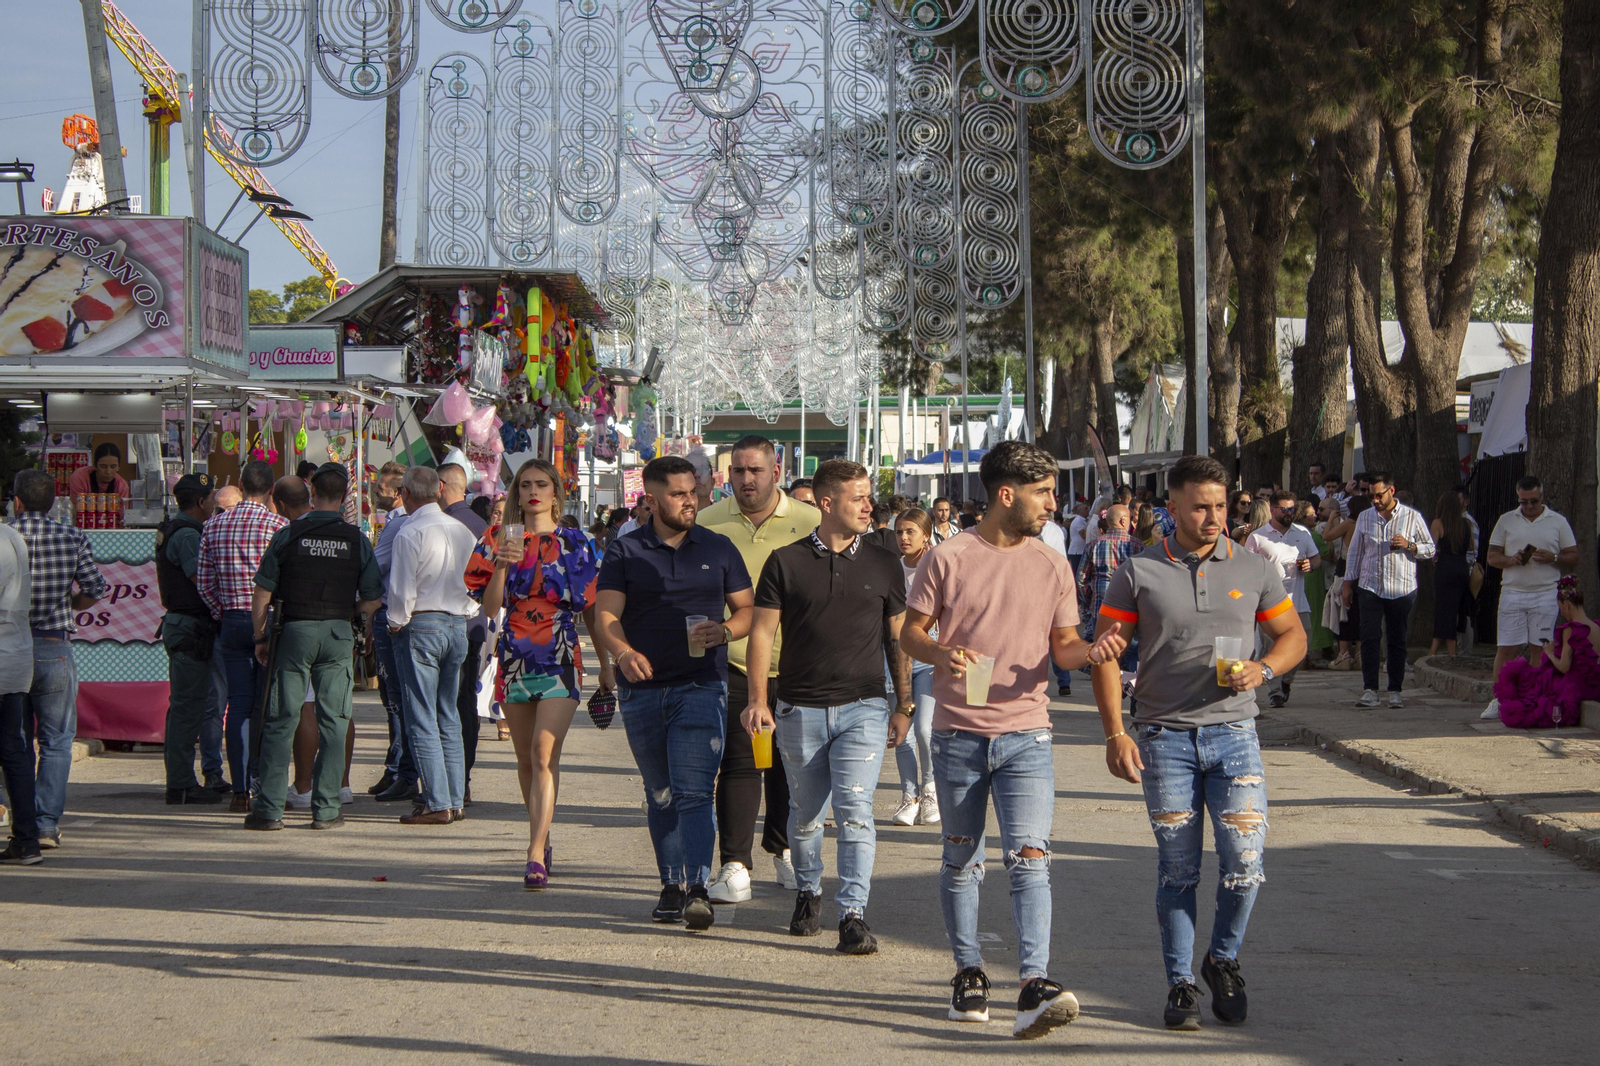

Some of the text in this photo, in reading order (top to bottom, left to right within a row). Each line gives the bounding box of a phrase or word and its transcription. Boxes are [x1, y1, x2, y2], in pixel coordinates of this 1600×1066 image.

[0, 224, 169, 328] RTESANOS
[259, 351, 271, 370] y
[272, 346, 336, 365] Chuches
[301, 538, 348, 550] GUARDIA
[310, 547, 338, 558] CIVIL
